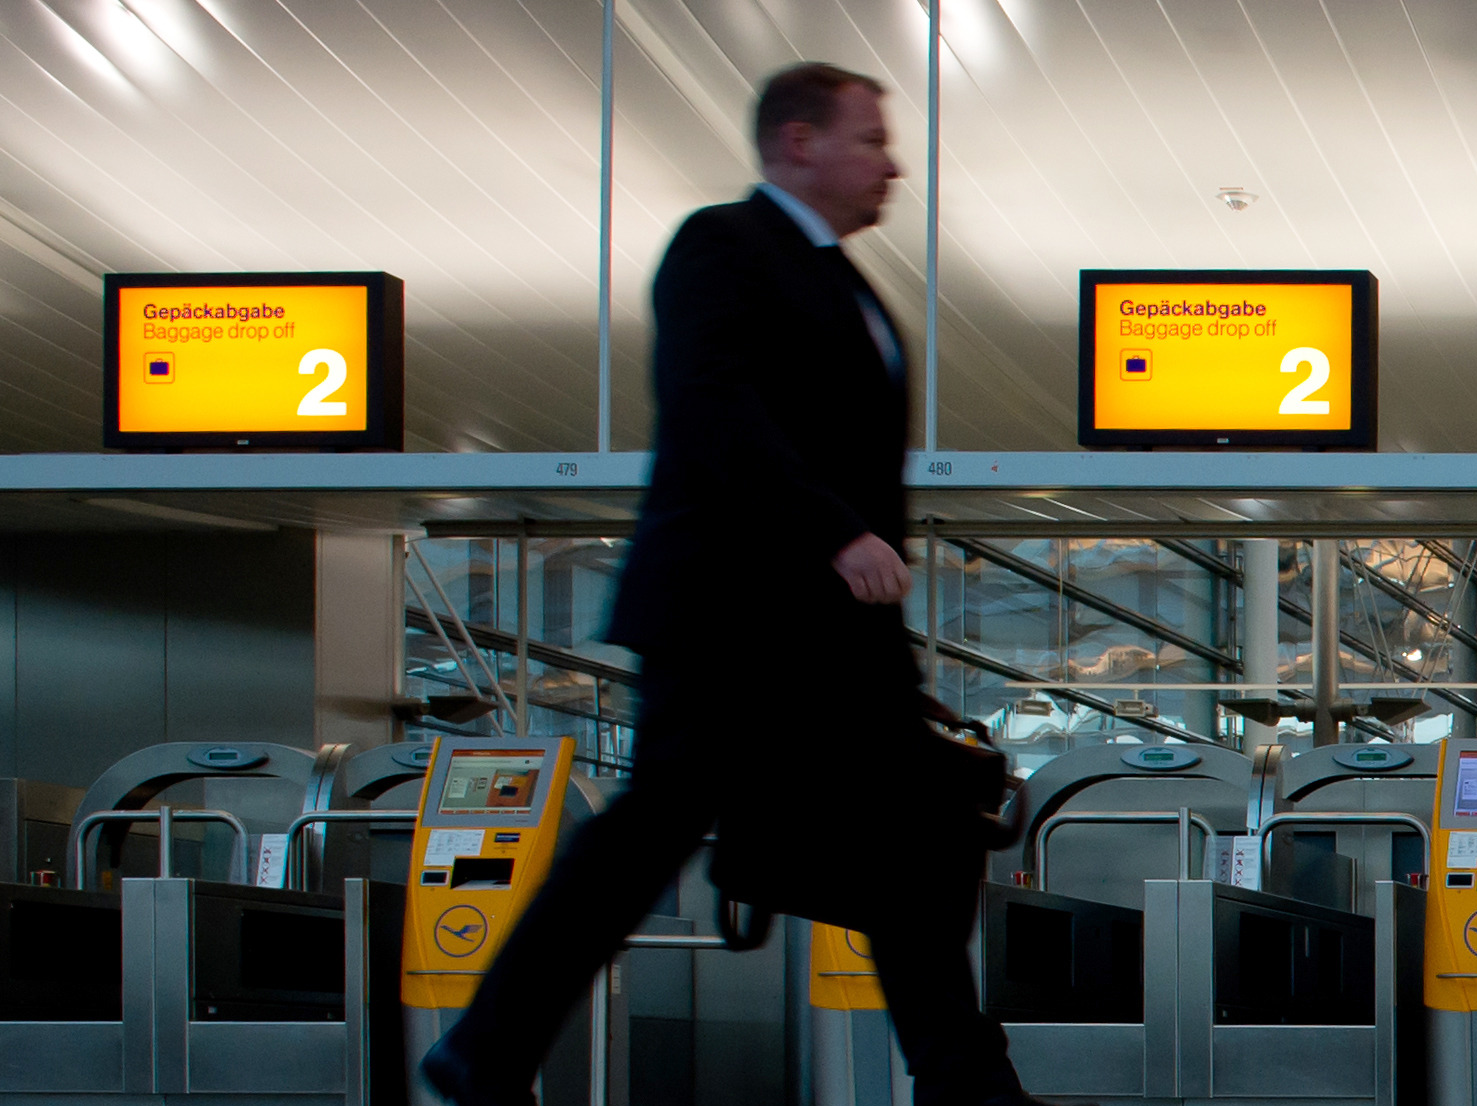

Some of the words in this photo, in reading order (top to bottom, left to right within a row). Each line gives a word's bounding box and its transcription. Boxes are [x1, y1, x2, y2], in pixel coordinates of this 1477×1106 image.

[143, 303, 285, 322] Gepäckabgabe
[1120, 300, 1266, 319] Gepäckabgabe
[143, 322, 223, 342] Baggage
[228, 322, 270, 341] drop
[273, 322, 295, 339] off
[1120, 320, 1203, 340] Baggage
[1208, 320, 1250, 340] drop
[1254, 320, 1277, 336] off
[296, 348, 347, 416] 2
[1278, 346, 1330, 414] 2
[556, 462, 578, 476] 479
[928, 462, 952, 476] 480
